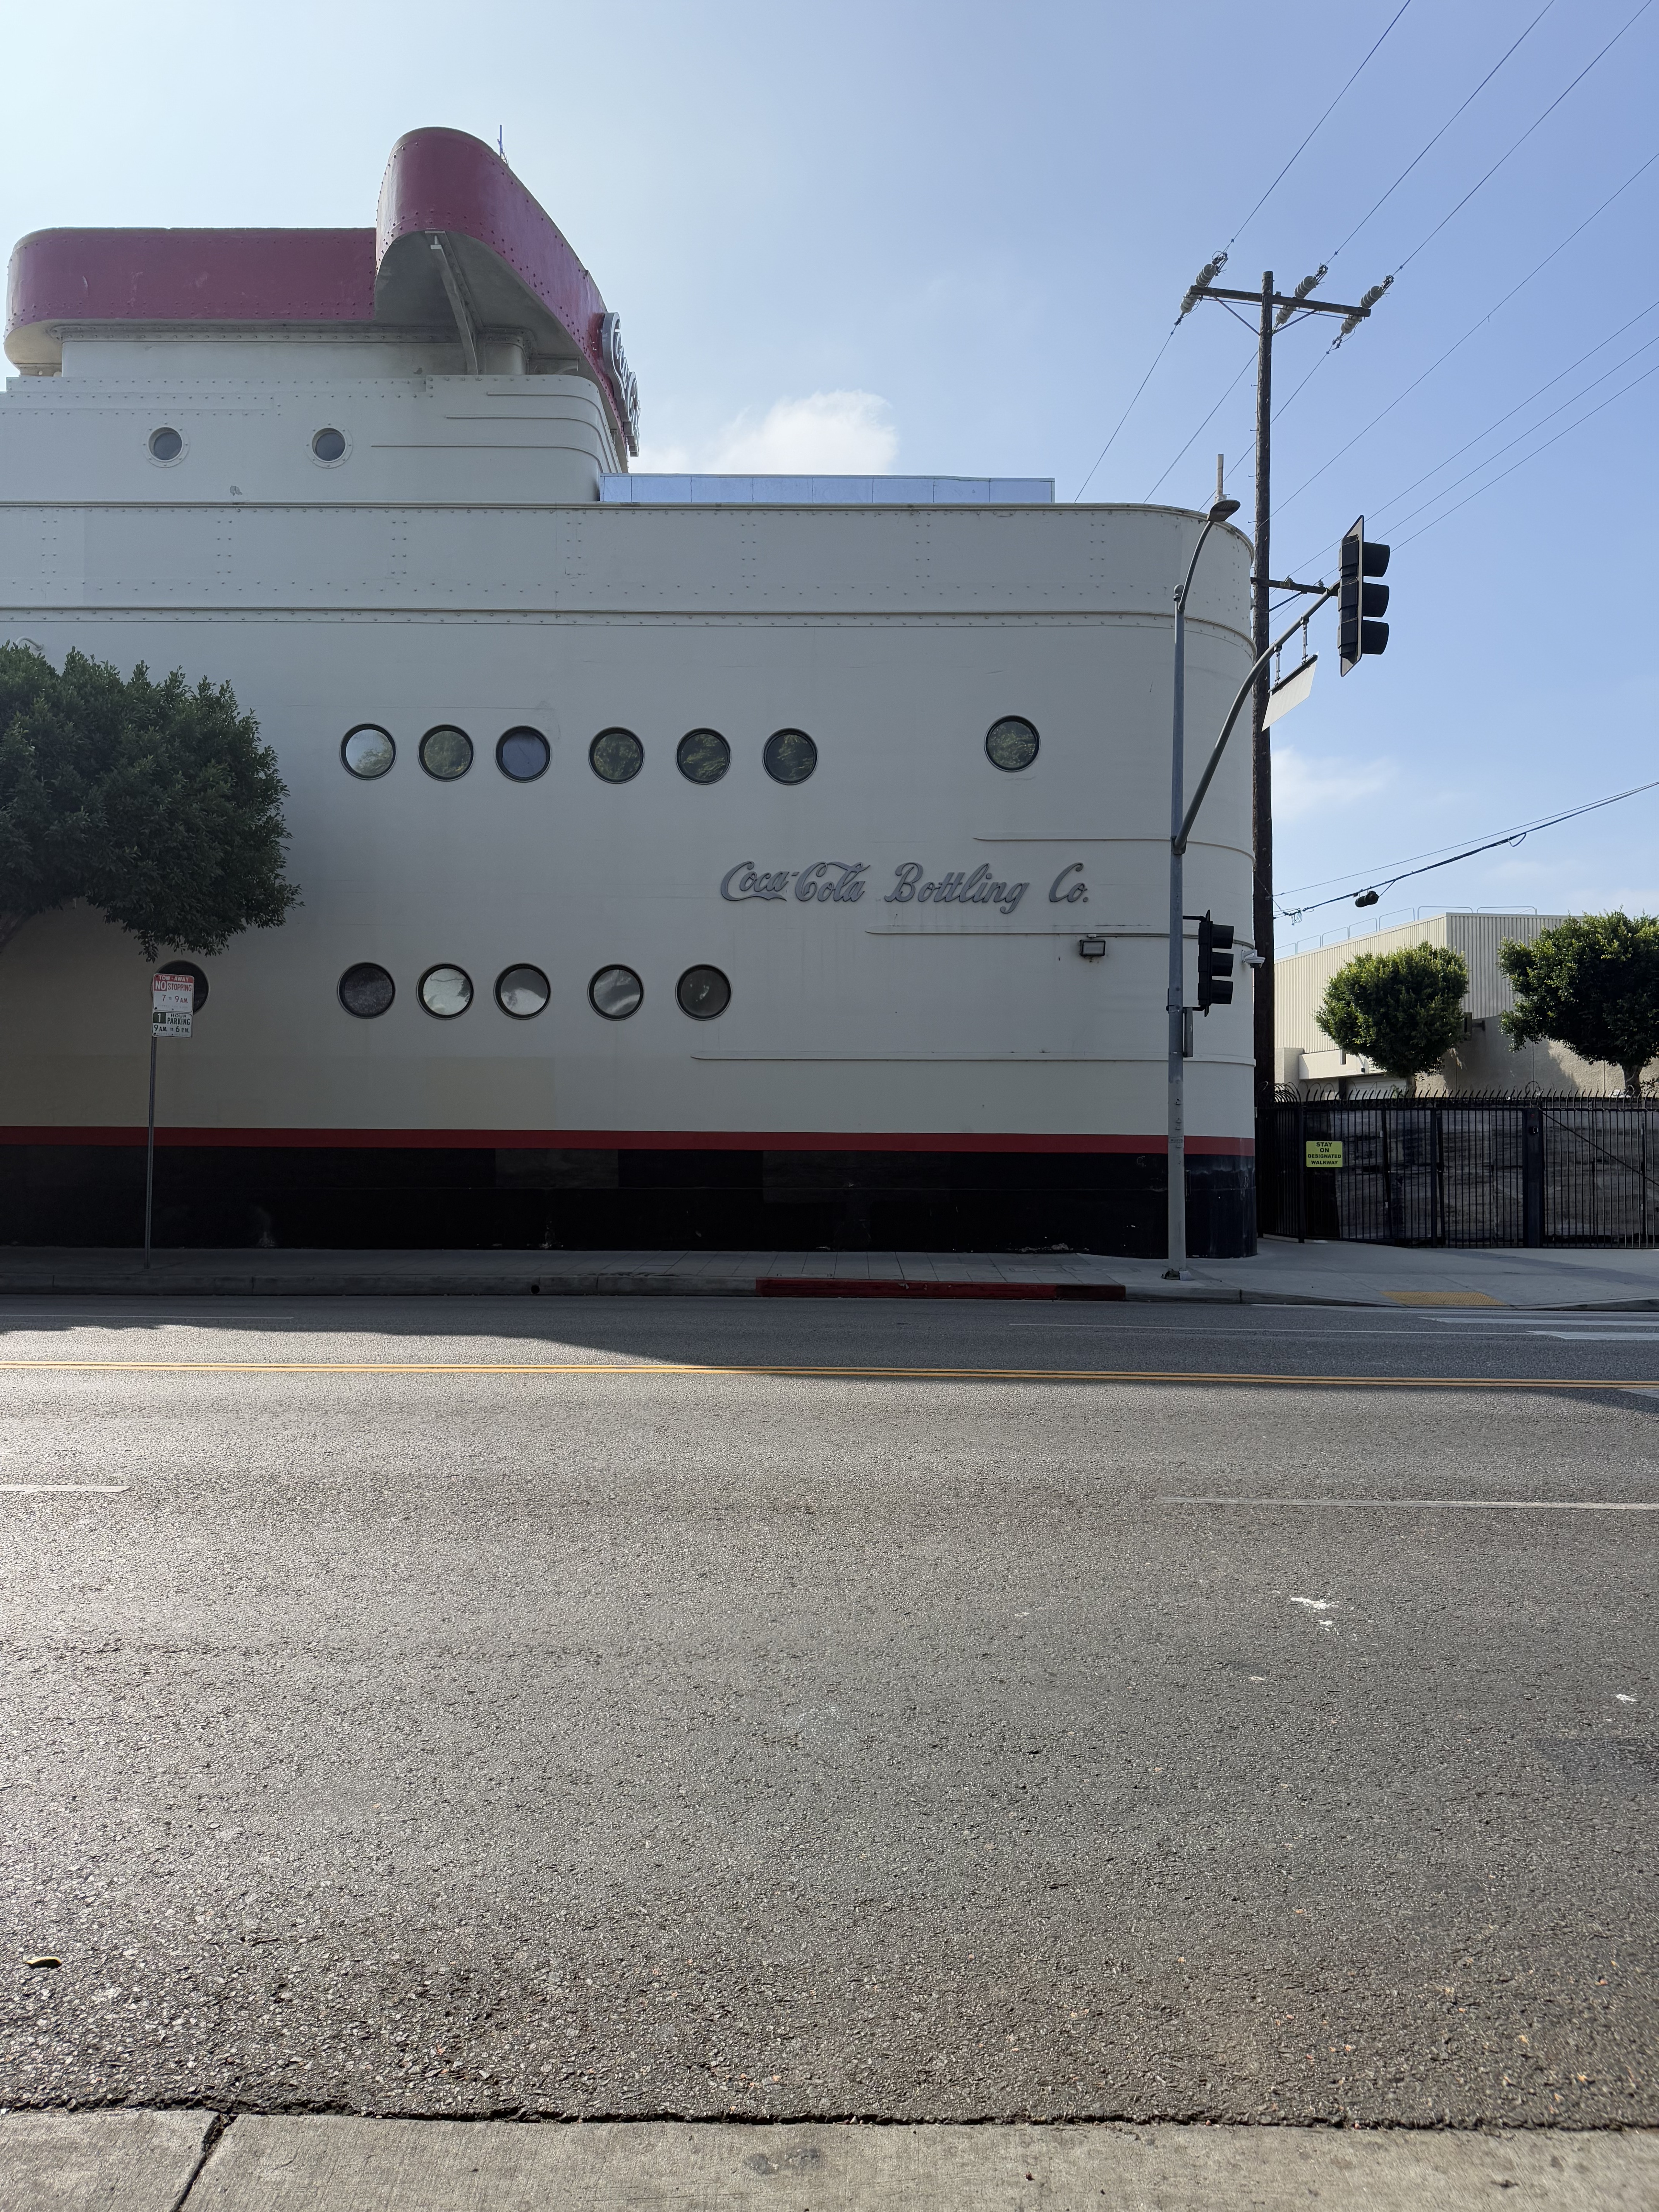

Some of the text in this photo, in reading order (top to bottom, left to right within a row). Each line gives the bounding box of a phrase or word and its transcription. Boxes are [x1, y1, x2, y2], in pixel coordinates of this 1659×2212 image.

[720, 861, 1089, 914] Coca-Cola Bottling Co.
[155, 981, 192, 991] NO STOPPING
[158, 1013, 161, 1022] 1
[167, 1017, 190, 1025] PARKING
